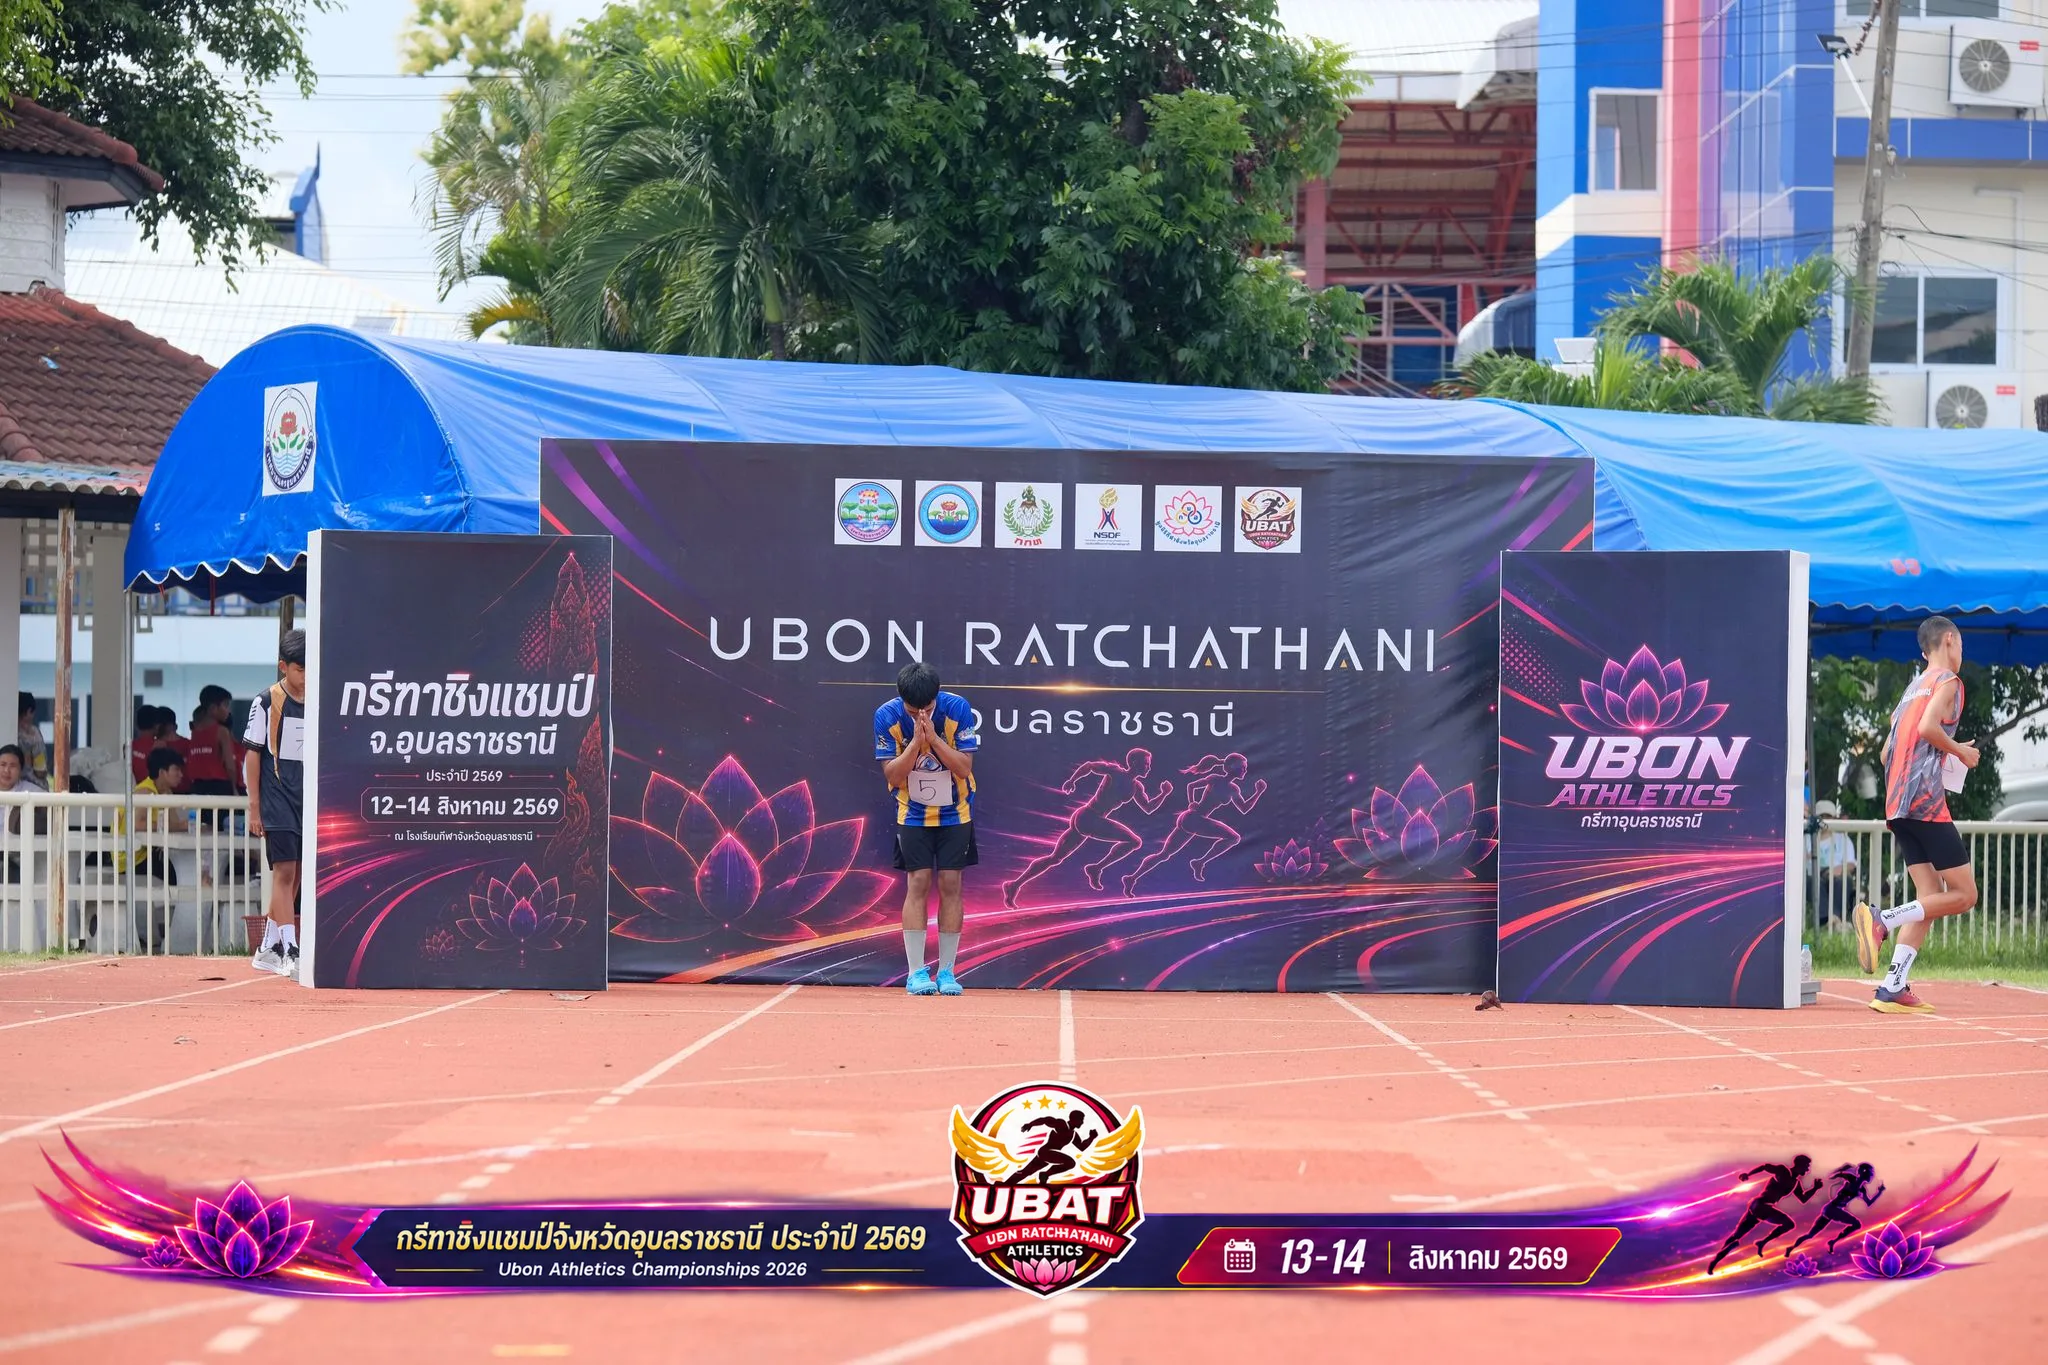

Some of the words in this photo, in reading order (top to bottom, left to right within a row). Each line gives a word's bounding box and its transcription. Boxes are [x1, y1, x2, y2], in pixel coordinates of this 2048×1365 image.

[1245, 520, 1291, 532] UBAT
[709, 616, 925, 663] UBON
[964, 621, 1436, 672] RATCHATHANI
[340, 670, 596, 717] กรีฑาชิงแชมป์
[370, 723, 558, 763] จ.อุบลราชธานี
[1545, 736, 1751, 779] UBON
[426, 769, 468, 782] ประจำปี
[472, 770, 503, 782] 2569
[918, 779, 937, 801] 5
[1547, 783, 1739, 806] ATHLETICS
[437, 795, 506, 816] สิงหาคม
[512, 798, 559, 815] 2569
[1580, 811, 1703, 832] กรีฑาอุบลราชธานี
[394, 832, 404, 841] ณ
[406, 830, 533, 844] โรงเรียนกีฬาจังหวัดอุบลราชธานี
